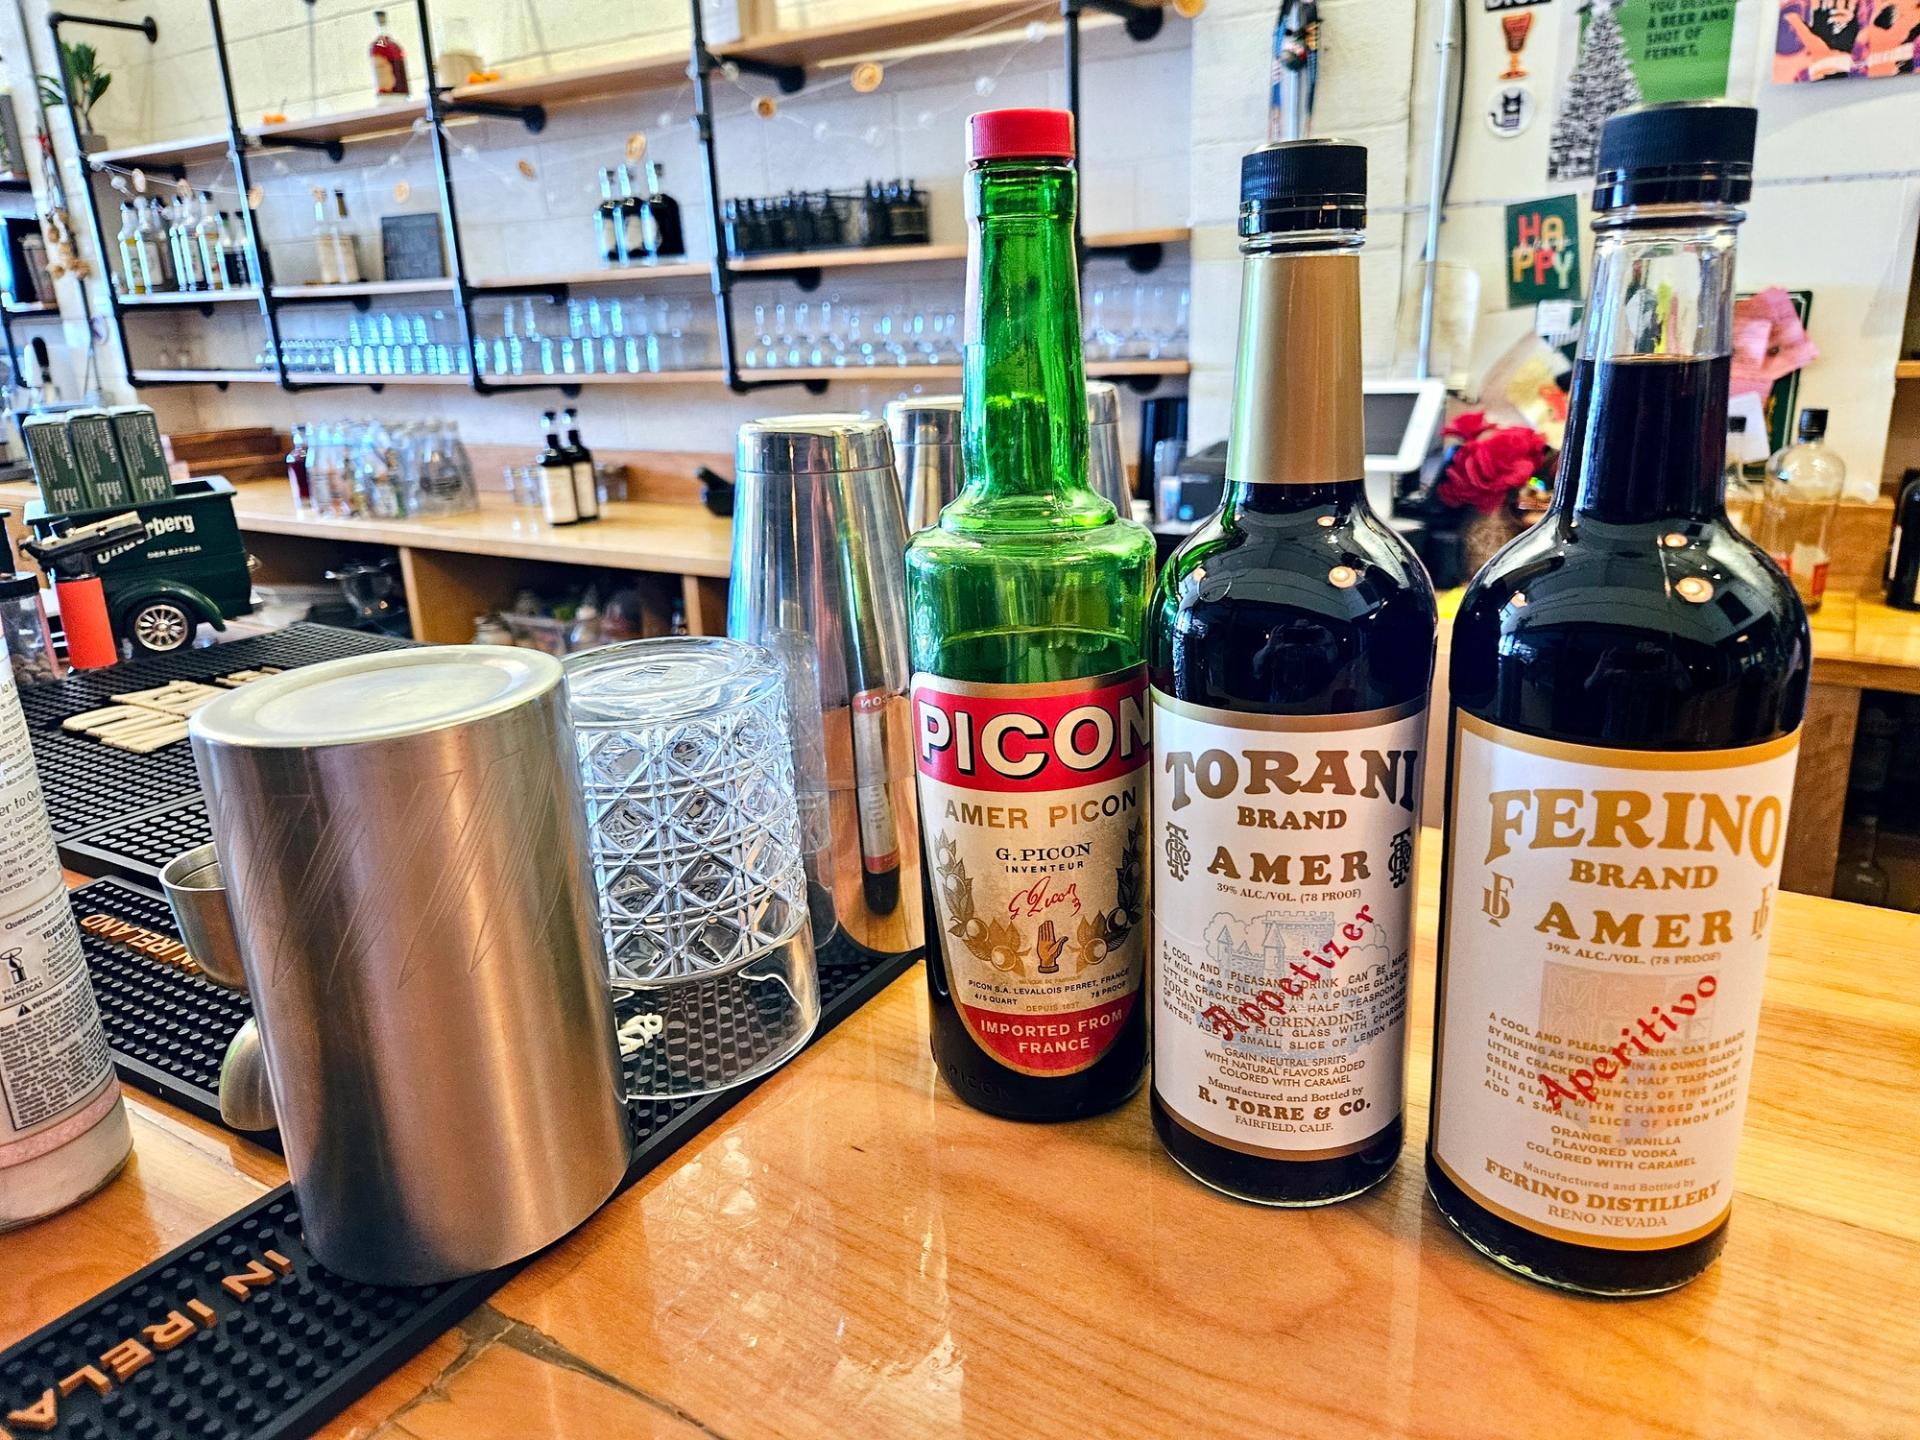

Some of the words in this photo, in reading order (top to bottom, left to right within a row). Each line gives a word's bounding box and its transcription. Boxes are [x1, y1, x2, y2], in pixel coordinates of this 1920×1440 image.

[1701, 8, 1729, 21] AND
[1646, 29, 1680, 46] SHOT
[1684, 25, 1703, 40] OF
[918, 688, 1150, 780] PICON
[1165, 749, 1418, 813] TORANI
[945, 800, 1028, 829] AMER
[1049, 787, 1136, 828] PICON
[1237, 806, 1347, 830] BRAND
[1484, 788, 1782, 869] FERINO
[1005, 861, 1084, 873] INVENTEUR
[1207, 846, 1371, 885] AMER
[1569, 858, 1719, 891] BRAND
[1217, 883, 1238, 895] 39%
[1300, 892, 1319, 903] (78
[1321, 888, 1362, 901] PROOF)
[1534, 901, 1734, 949] AMER
[1172, 946, 1193, 965] COOL
[1200, 962, 1220, 975] AND
[1301, 978, 1339, 989] DRINK
[1348, 971, 1368, 984] CAN
[1376, 964, 1386, 976] BE
[1546, 942, 1571, 957] 39%
[1650, 954, 1669, 967] (78
[968, 979, 993, 992] PICON
[1014, 986, 1062, 995] LEVALLOIS
[1064, 979, 1099, 993] PERRET,
[1100, 967, 1129, 984] FRANCE
[1163, 951, 1172, 963] BY
[1174, 960, 1205, 982] MIXING
[1209, 978, 1222, 988] AS
[1309, 992, 1318, 1000] A
[1333, 983, 1370, 999] OUNCE
[1201, 904, 1375, 1042] Appetizer
[4, 981, 43, 1003] MISTICAS
[989, 996, 1018, 1006] QUART
[1091, 991, 1100, 999] 78
[1101, 980, 1127, 997] PROOF
[1163, 963, 1189, 987] LITTLE
[1195, 984, 1247, 1005] CRACKED
[1289, 1005, 1297, 1013] A
[1307, 1003, 1340, 1013] HALF
[1349, 983, 1395, 1008] TEASPOON
[1163, 974, 1203, 1008] TORANI
[1026, 1004, 1058, 1012] DEPUIS
[1176, 996, 1196, 1014] THIS
[980, 1019, 1070, 1037] IMPORTED
[1078, 1009, 1122, 1033] FROM
[1255, 1025, 1284, 1037] FILL
[1291, 1028, 1330, 1038] GLASS
[1339, 1020, 1367, 1034] WITH
[1489, 1011, 1497, 1021] A
[1500, 1017, 1530, 1036] COOL
[1535, 1031, 1561, 1045] AND
[1682, 1044, 1705, 1055] CAN
[1019, 1037, 1090, 1054] FRANCE
[1240, 1034, 1282, 1048] SMALL
[1289, 1040, 1325, 1050] SLICE
[1332, 1038, 1347, 1047] OF
[1354, 1025, 1385, 1043] LEMON
[1488, 1025, 1502, 1037] BY
[1503, 1032, 1546, 1054] MIXING
[1549, 1050, 1564, 1060] AS
[1649, 1063, 1656, 1071] A
[1670, 1057, 1708, 1070] OUNCE
[1536, 974, 1718, 1112] Aperitivo
[1204, 1049, 1229, 1066] WITH
[1231, 1059, 1279, 1076] NATURAL
[1283, 1067, 1329, 1077] FLAVORS
[1333, 1059, 1366, 1075] ADDED
[1224, 1047, 1257, 1062] GRAIN
[1260, 1055, 1309, 1068] NEUTRAL
[1312, 1054, 1347, 1067] SPIRITS
[1487, 1038, 1519, 1060] LITTLE
[1526, 1056, 1587, 1078] CRACKE
[1621, 1076, 1629, 1085] A
[1637, 1076, 1669, 1085] HALF
[1675, 1065, 1729, 1084] TEASPOON
[1207, 1075, 1284, 1101] Manufactured
[1286, 1093, 1308, 1102] and
[1311, 1089, 1350, 1103] Bottled
[1352, 1085, 1364, 1097] by
[1219, 1065, 1269, 1085] COLORED
[1272, 1077, 1301, 1087] WITH
[1304, 1074, 1352, 1088] CARAMEL
[1486, 1065, 1510, 1084] FILL
[1624, 1102, 1694, 1114] CHARGED
[1198, 1084, 1218, 1105] R.
[1226, 1096, 1305, 1121] TORRE
[1313, 1106, 1331, 1121] &
[1339, 1097, 1371, 1117] CO.
[1484, 1079, 1509, 1097] ADD
[1516, 1095, 1525, 1104] A
[1532, 1101, 1580, 1121] SMALL
[1589, 1115, 1631, 1127] SLICE
[1640, 1119, 1658, 1128] OF
[1667, 1113, 1709, 1127] LEMON
[1591, 1087, 1648, 1100] OUNCES
[1657, 1091, 1674, 1100] OF
[1682, 1086, 1707, 1097] THIS
[1235, 1114, 1297, 1134] FAIRFIELD,
[1299, 1122, 1334, 1133] CALIF.
[1551, 1126, 1612, 1144] ORANGE
[1624, 1135, 1681, 1147] VANILLA
[1526, 1141, 1592, 1166] COLORED
[1596, 1159, 1634, 1170] WITH
[1638, 1157, 1697, 1171] CARAMEL
[1552, 1138, 1628, 1158] FLAVORED
[1632, 1149, 1678, 1159] VODKA
[1484, 1157, 1580, 1205] FERINO
[1586, 1180, 1721, 1213] DISTILLERY
[1523, 1160, 1609, 1190] Manufactured
[1613, 1182, 1636, 1192] and
[1640, 1180, 1681, 1192] Bottled
[1683, 1178, 1696, 1189] by
[1548, 1205, 1597, 1224] RENO
[1601, 1216, 1668, 1228] NEVADA
[222, 1249, 292, 1302] IN
[6, 1298, 217, 1433] IRELA
